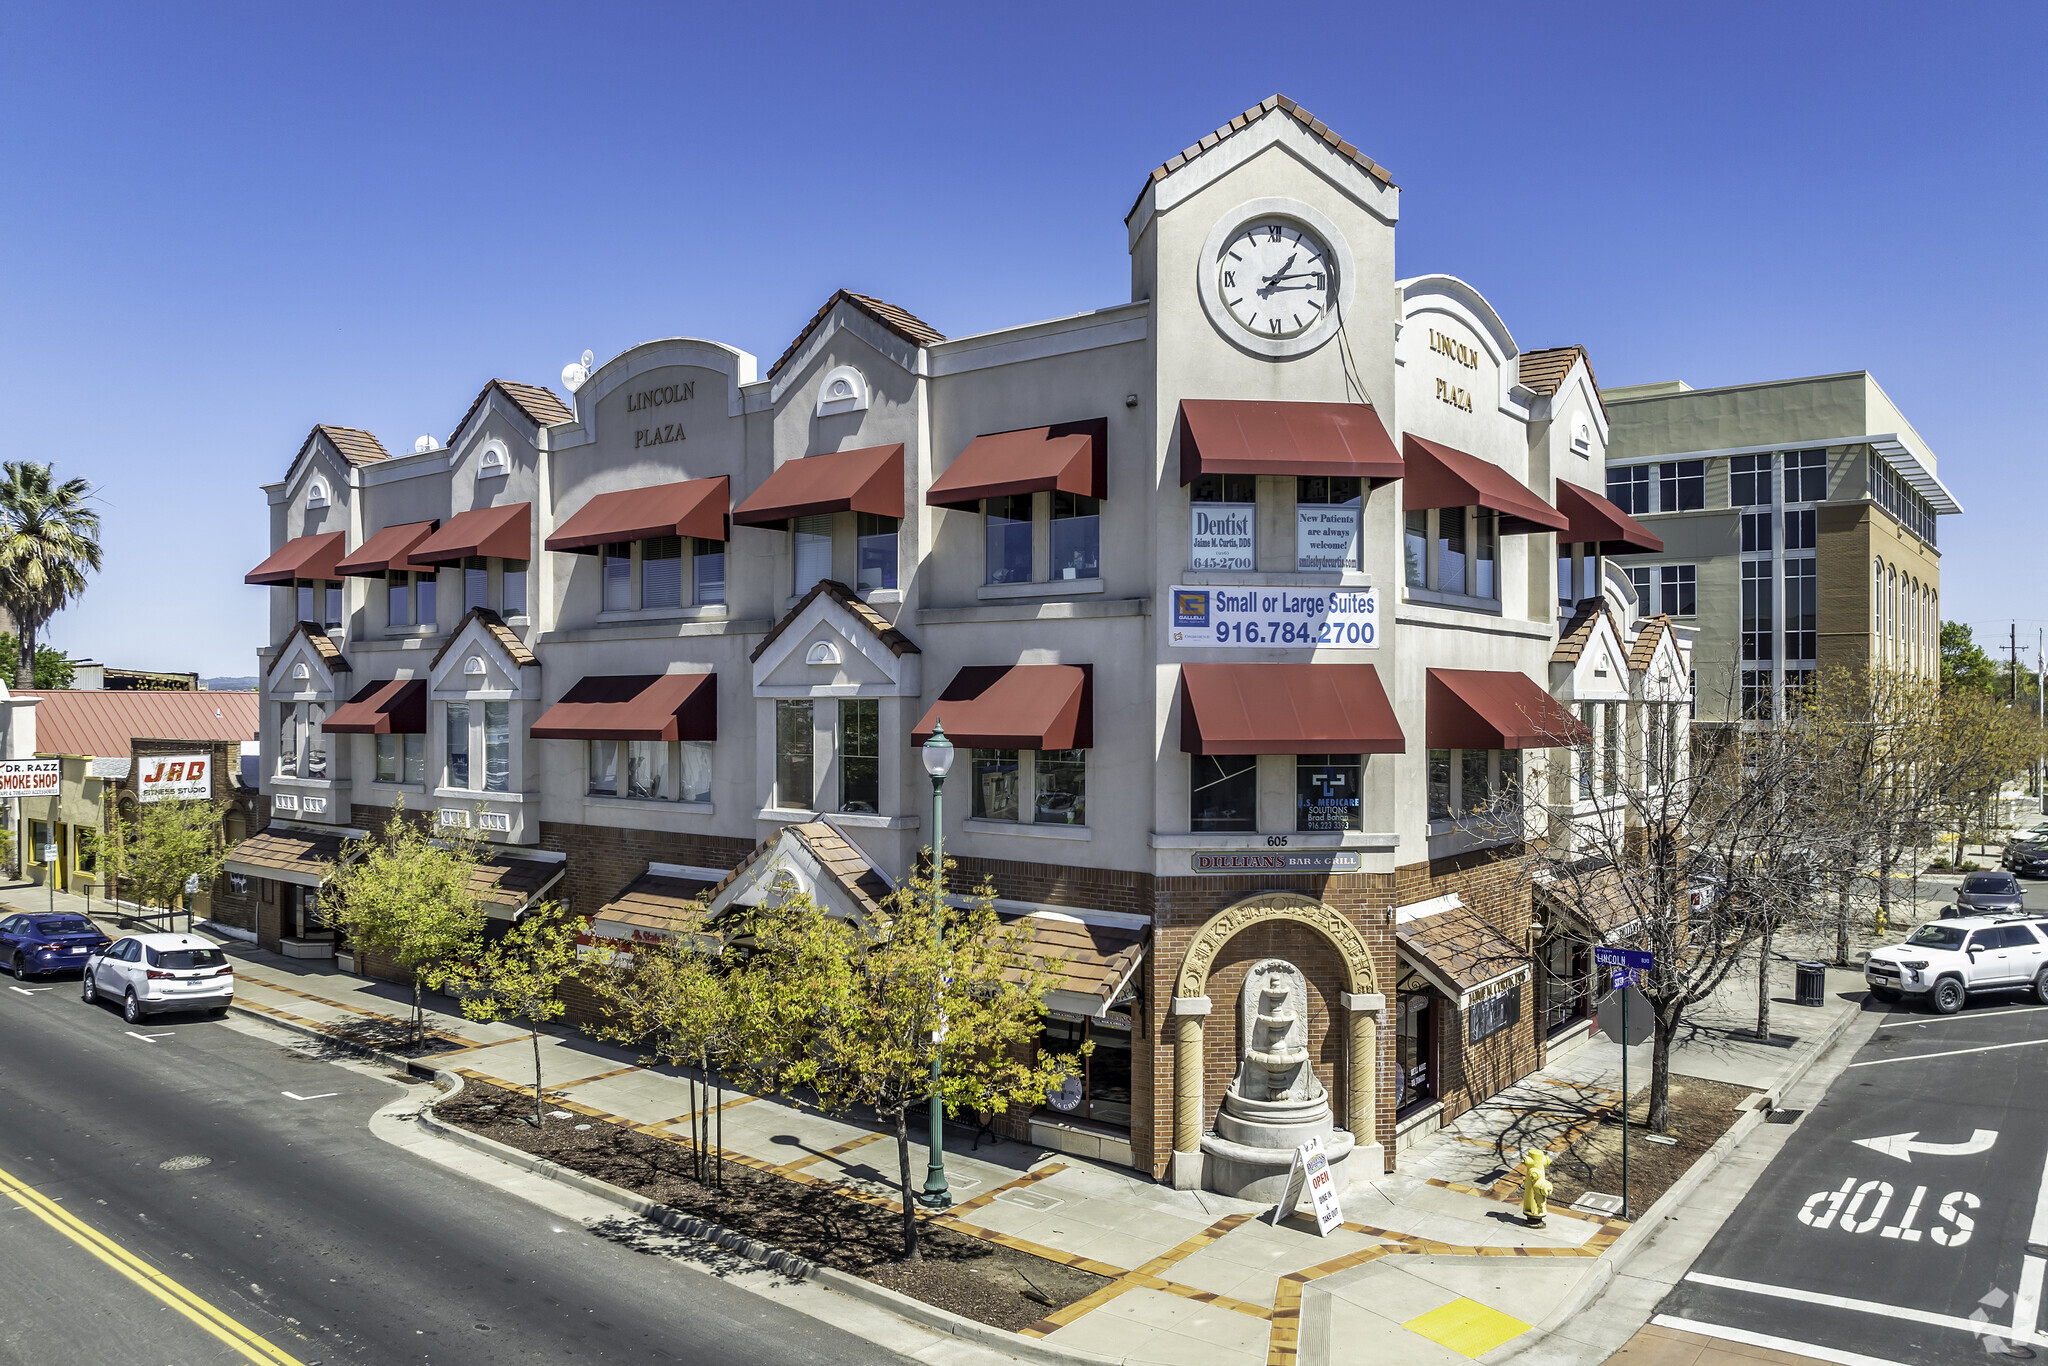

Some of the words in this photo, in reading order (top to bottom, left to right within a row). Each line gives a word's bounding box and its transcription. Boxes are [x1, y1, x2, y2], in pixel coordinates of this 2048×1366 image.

[1268, 318, 1282, 334] VI
[1429, 328, 1478, 370] LINCOLN
[626, 381, 695, 413] LINCOLN
[1435, 377, 1473, 414] PLAZA
[634, 423, 686, 449] PLAZA
[1195, 512, 1248, 536] Dentist
[1299, 513, 1318, 523] New
[1320, 513, 1354, 524] Patients
[1322, 527, 1350, 539] always
[1193, 537, 1210, 548] Jaime
[1238, 537, 1251, 548] DDS
[1310, 541, 1348, 550] welcome!
[1193, 557, 1251, 570] 645-2700
[1298, 555, 1357, 570] smilesbydrcurtis.com
[1216, 591, 1257, 613] Small
[1262, 596, 1278, 613] or
[1282, 591, 1324, 618] Large
[1329, 592, 1375, 614] Suites
[1216, 620, 1375, 644] 916.784.2700
[5, 764, 24, 773] DR.
[27, 763, 58, 772] RAZZ
[0, 774, 31, 790] SMOKE
[33, 773, 58, 789] SHOP
[143, 788, 175, 796] FITNESS
[177, 786, 207, 795] STUDIO
[1297, 799, 1314, 807] U.S.
[1317, 798, 1360, 807] MEDICARE
[1308, 806, 1348, 814] SOLUTIONS
[1307, 813, 1325, 821] Brad
[1326, 813, 1349, 821] Bahan
[1307, 821, 1332, 830] 916.223
[1333, 821, 1349, 830] 3393
[1267, 835, 1288, 847] 605
[1198, 855, 1287, 869] DILLIANS
[1288, 857, 1311, 865] BAR
[1324, 857, 1357, 866] GRILL
[1596, 953, 1626, 965] LINCOLN
[1312, 1170, 1330, 1190] OPEN
[1797, 1177, 1981, 1247] STOP
